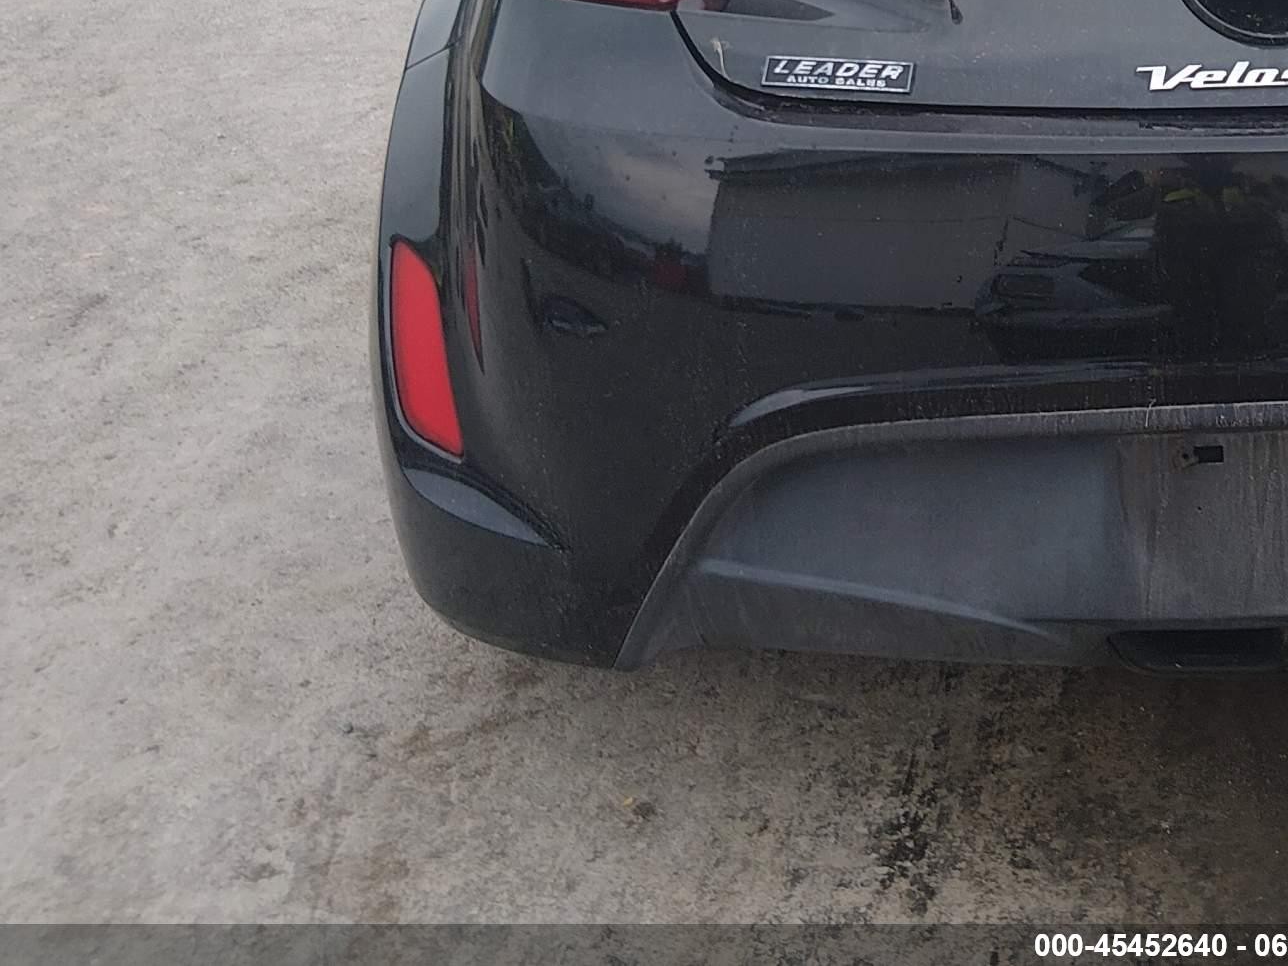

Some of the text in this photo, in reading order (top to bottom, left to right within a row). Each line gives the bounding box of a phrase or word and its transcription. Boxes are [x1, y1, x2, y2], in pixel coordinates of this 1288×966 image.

[773, 60, 904, 80] LEADER
[787, 75, 886, 88] AUTO SALES
